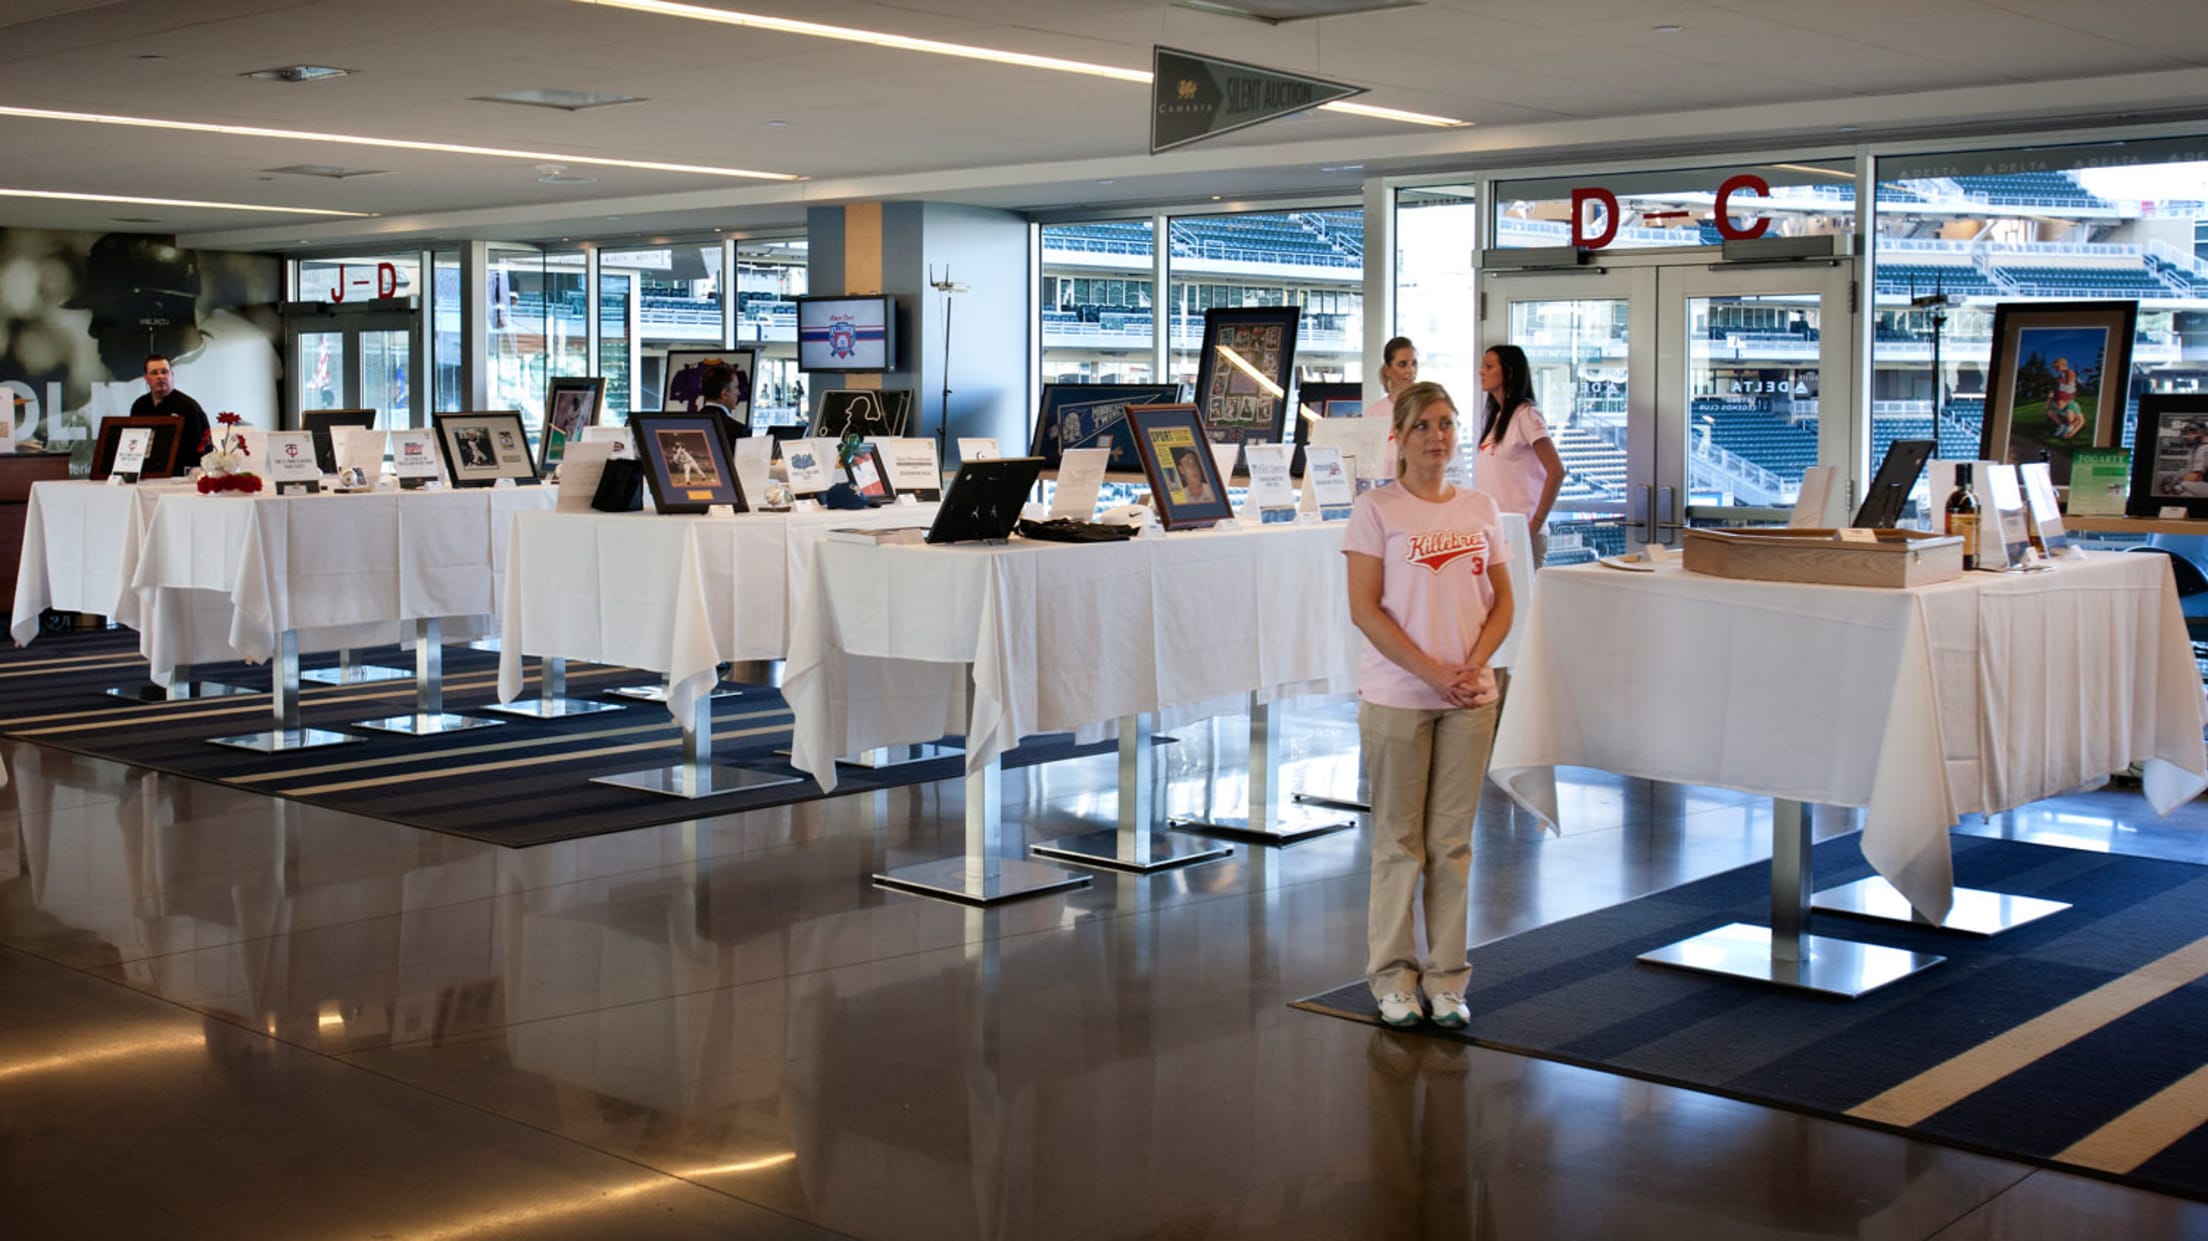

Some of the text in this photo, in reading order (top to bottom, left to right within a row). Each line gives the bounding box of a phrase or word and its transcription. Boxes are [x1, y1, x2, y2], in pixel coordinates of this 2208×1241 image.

[1226, 77, 1313, 114] SILENT AUCTION
[1912, 166, 1960, 177] DELTA
[1999, 160, 2048, 172] DELTA
[1471, 556, 1484, 576] 3
